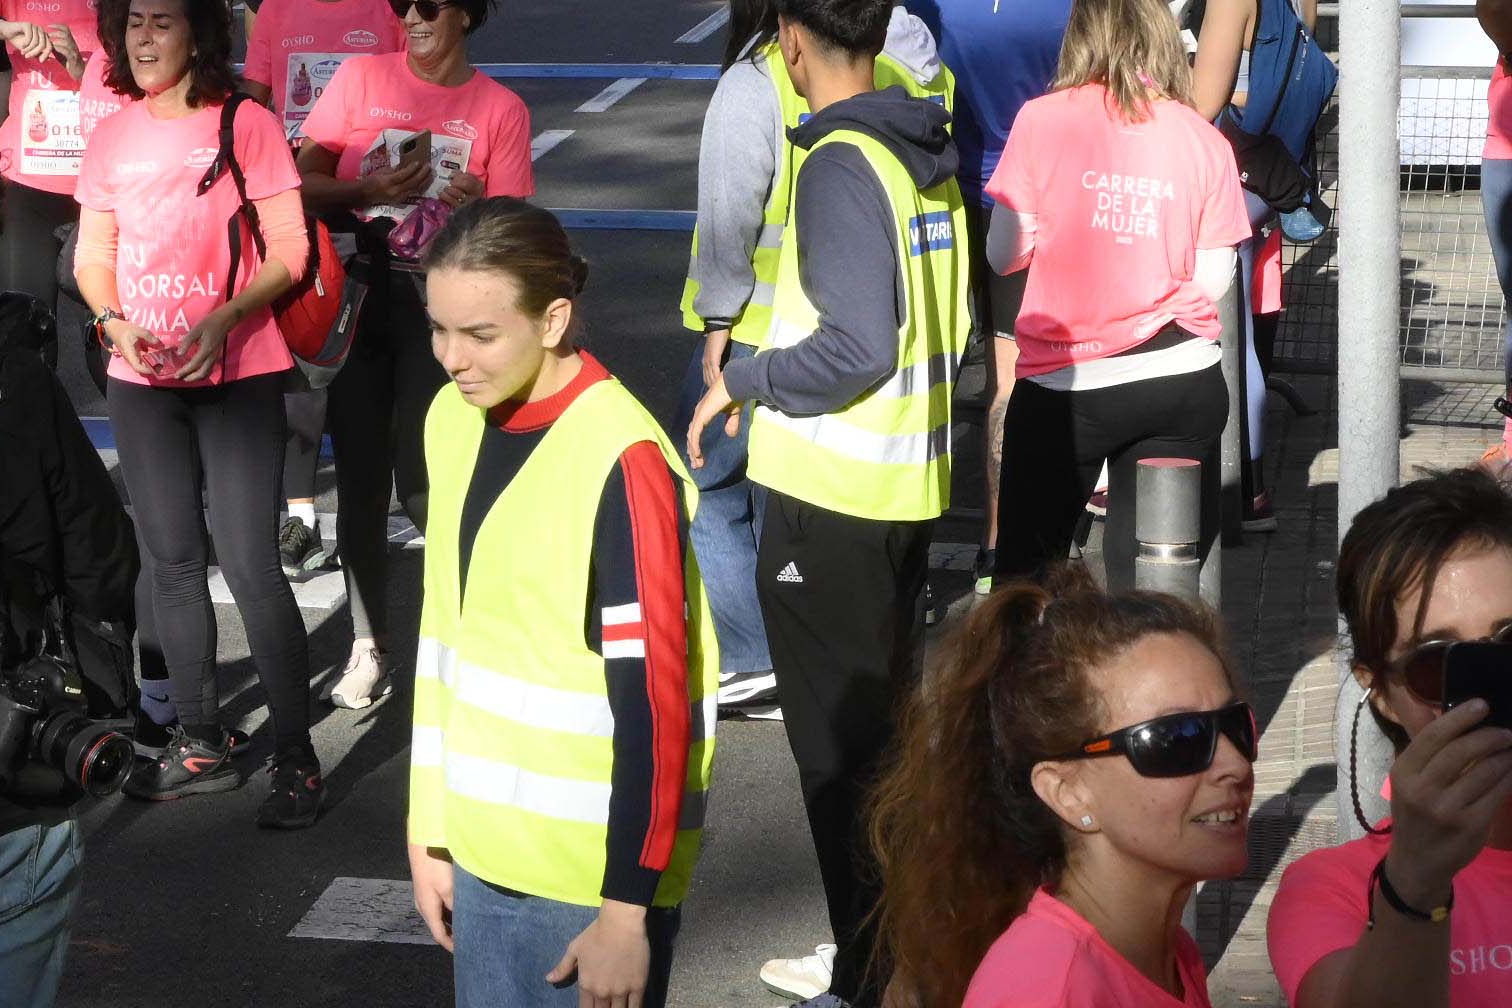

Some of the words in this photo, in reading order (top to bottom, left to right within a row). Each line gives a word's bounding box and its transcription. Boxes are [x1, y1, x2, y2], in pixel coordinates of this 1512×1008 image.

[281, 34, 315, 49] OYSHO
[30, 69, 52, 89] TU
[369, 106, 412, 122] OYSHO
[1081, 170, 1176, 201] CARRERA
[1097, 191, 1128, 211] DE
[1130, 196, 1157, 216] LA
[1090, 214, 1159, 240] MUJER
[126, 272, 219, 299] DORSAL
[777, 574, 803, 583] adidas
[1449, 944, 1512, 976] SHO
